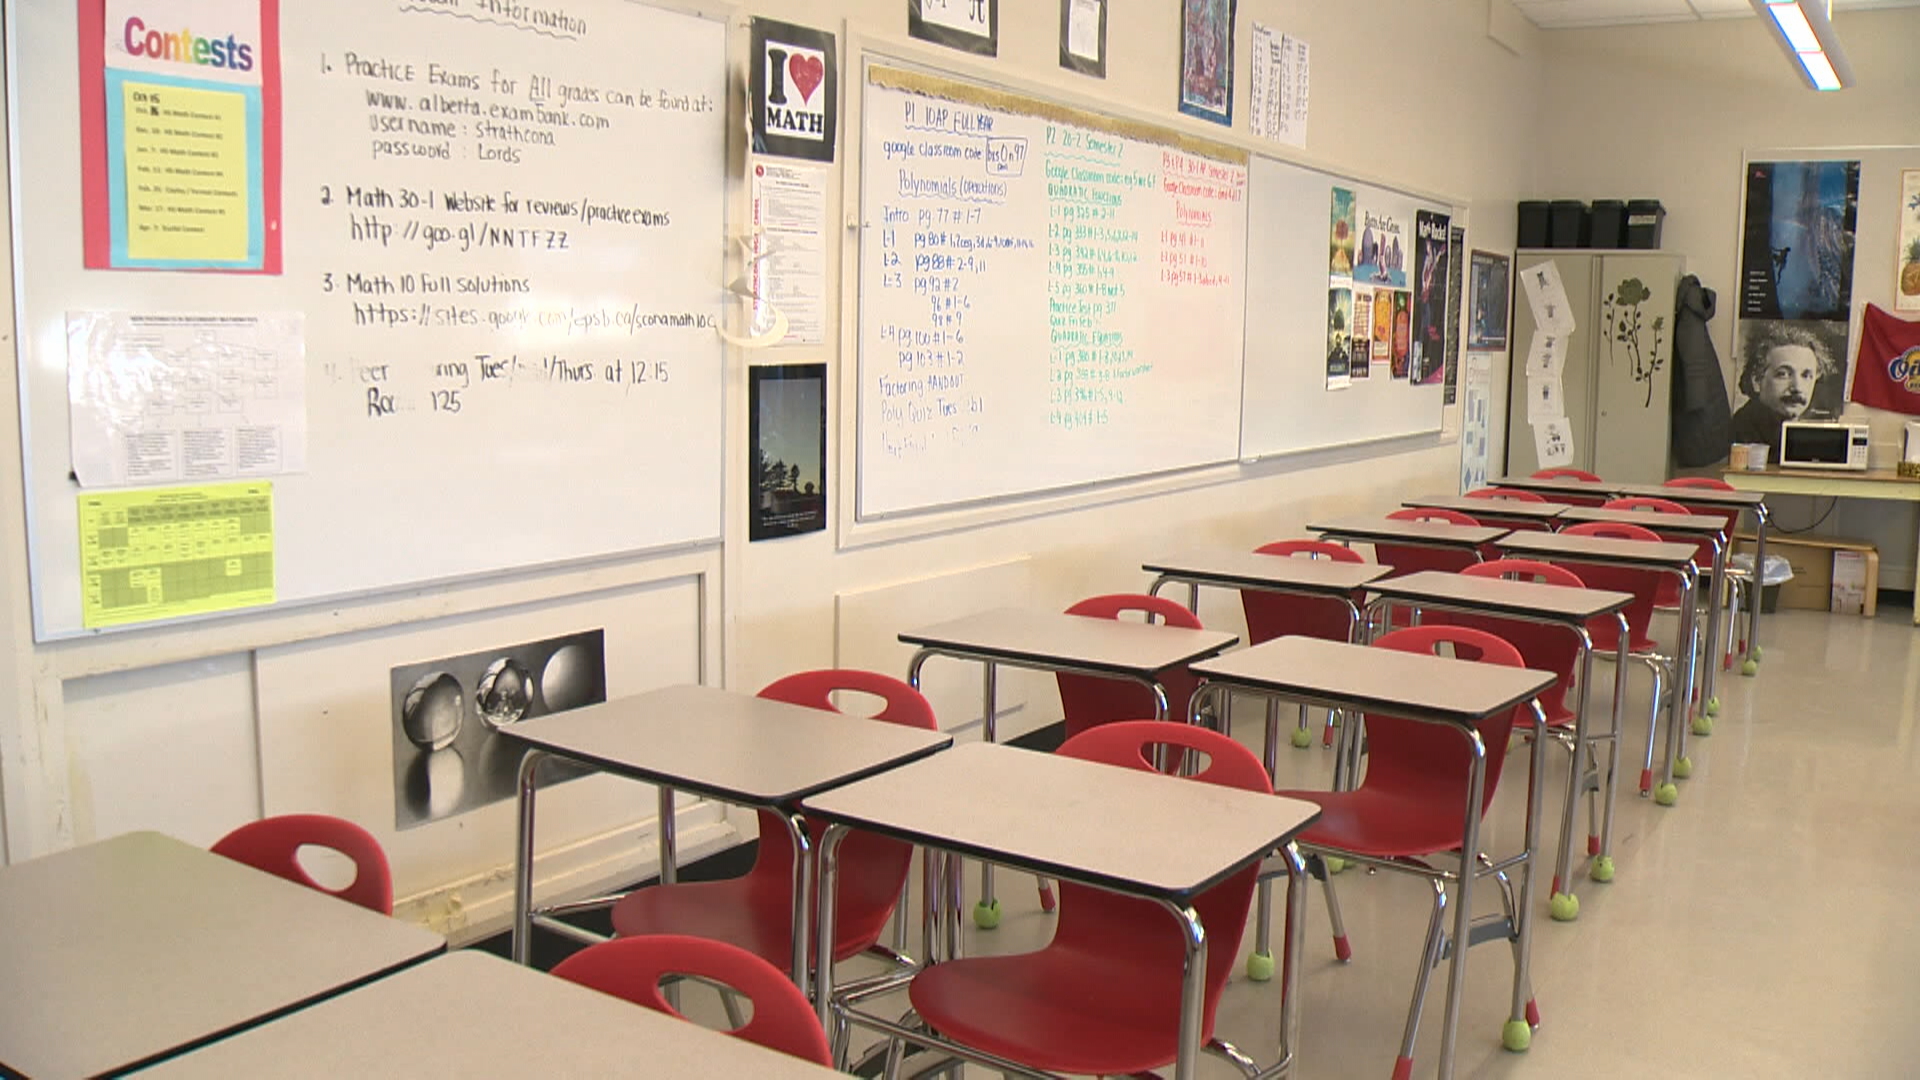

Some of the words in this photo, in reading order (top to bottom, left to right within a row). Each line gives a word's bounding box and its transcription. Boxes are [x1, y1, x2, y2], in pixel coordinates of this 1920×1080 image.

[124, 16, 253, 71] Contests
[429, 63, 480, 90] Exams
[490, 68, 518, 95] for
[529, 74, 551, 101] All
[558, 84, 600, 108] grades
[606, 89, 634, 105] can
[640, 89, 651, 107] be
[659, 88, 689, 111] found
[768, 49, 788, 105] I
[767, 107, 823, 133] MATH
[373, 140, 451, 160] password
[479, 143, 521, 164] Lords
[883, 140, 915, 160] google
[919, 141, 961, 158] classroom
[965, 146, 982, 160] code
[899, 169, 957, 196] Polynomials
[346, 186, 394, 208] Math
[400, 189, 433, 209] 30-1
[444, 191, 496, 213] Website
[502, 191, 519, 213] for
[884, 205, 909, 224] Intro
[937, 207, 950, 224] 77
[346, 272, 395, 295] Math
[401, 274, 415, 293] 10
[605, 358, 623, 383] at
[879, 375, 924, 397] Factoring
[431, 390, 462, 414] 125
